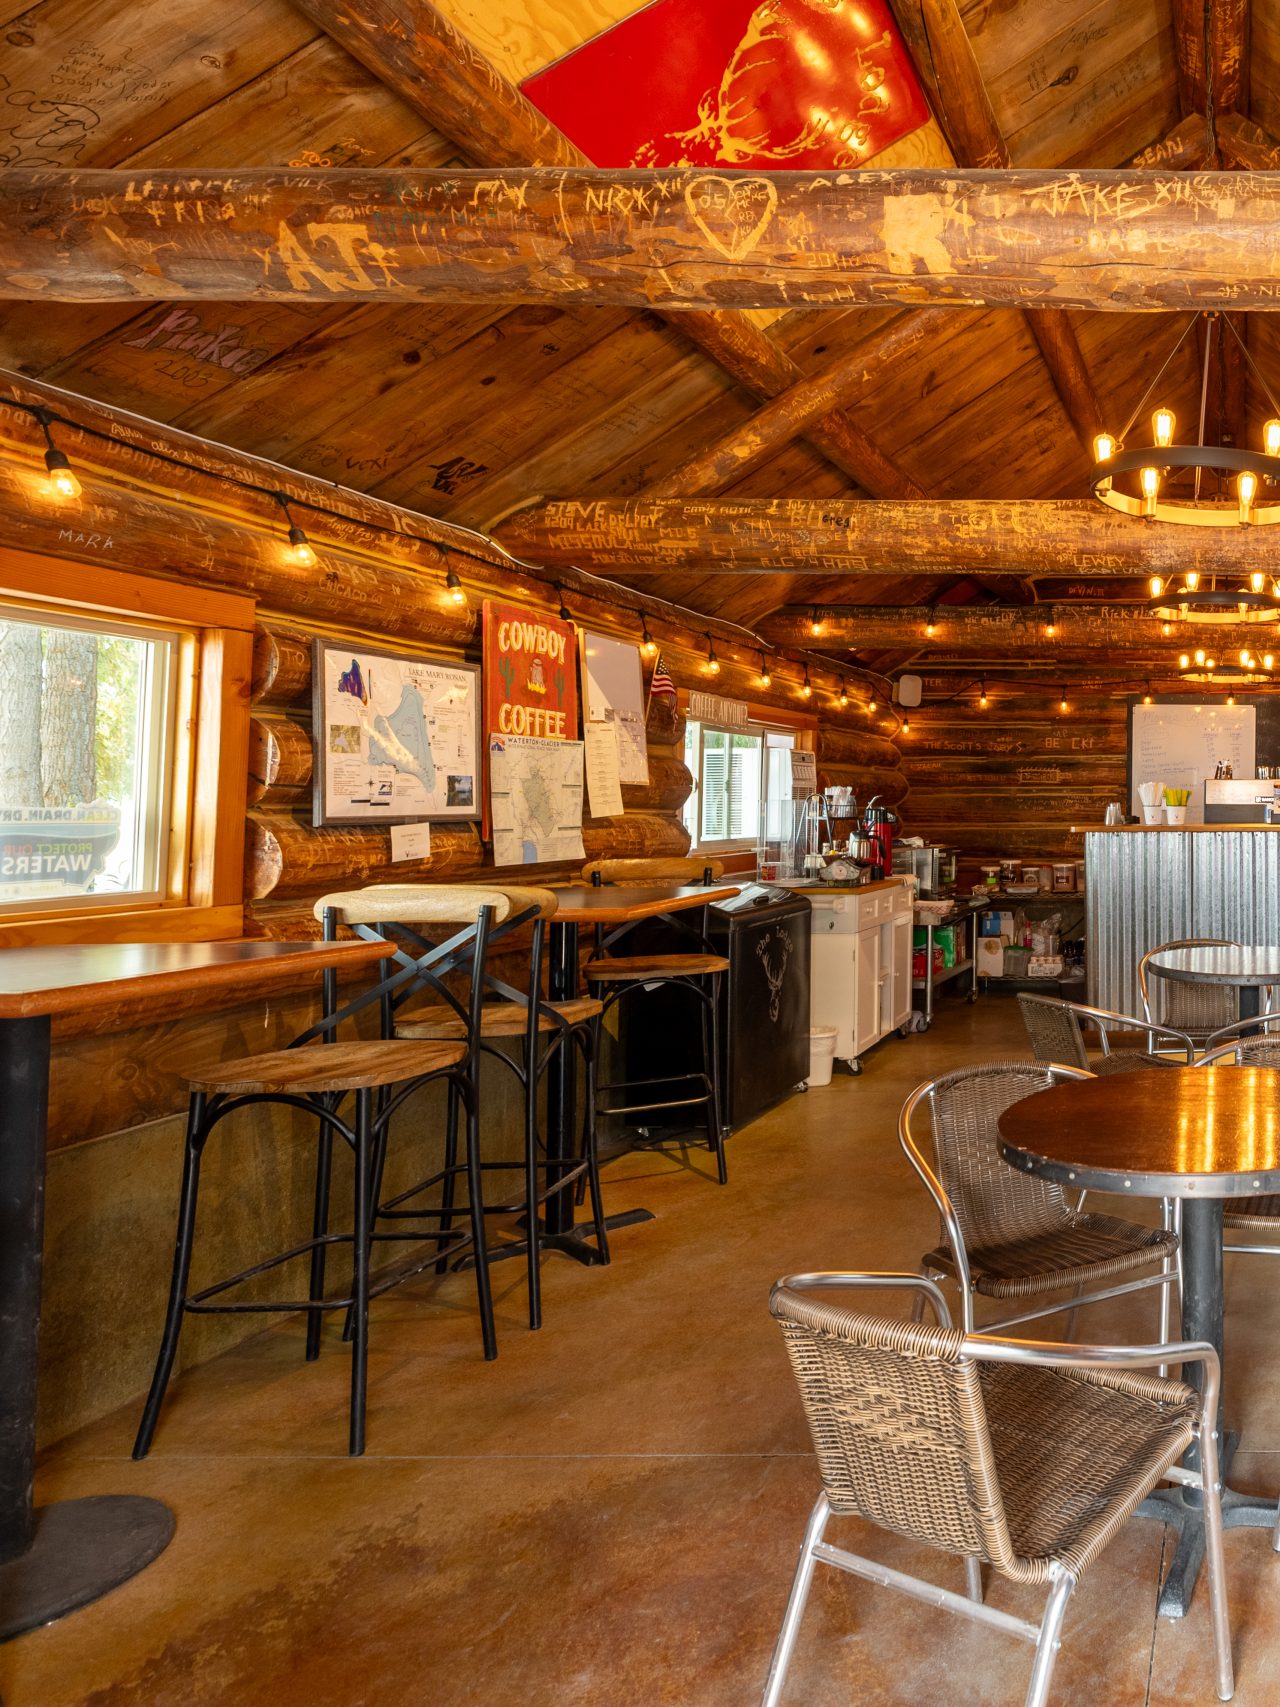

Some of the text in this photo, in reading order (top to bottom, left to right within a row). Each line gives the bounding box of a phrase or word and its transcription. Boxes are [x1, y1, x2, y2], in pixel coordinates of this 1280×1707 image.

[822, 514, 850, 528] Greg
[498, 621, 567, 665] COWBOY
[408, 667, 424, 677] LAKE
[426, 670, 444, 680] MARY
[499, 703, 566, 741] COFFEE
